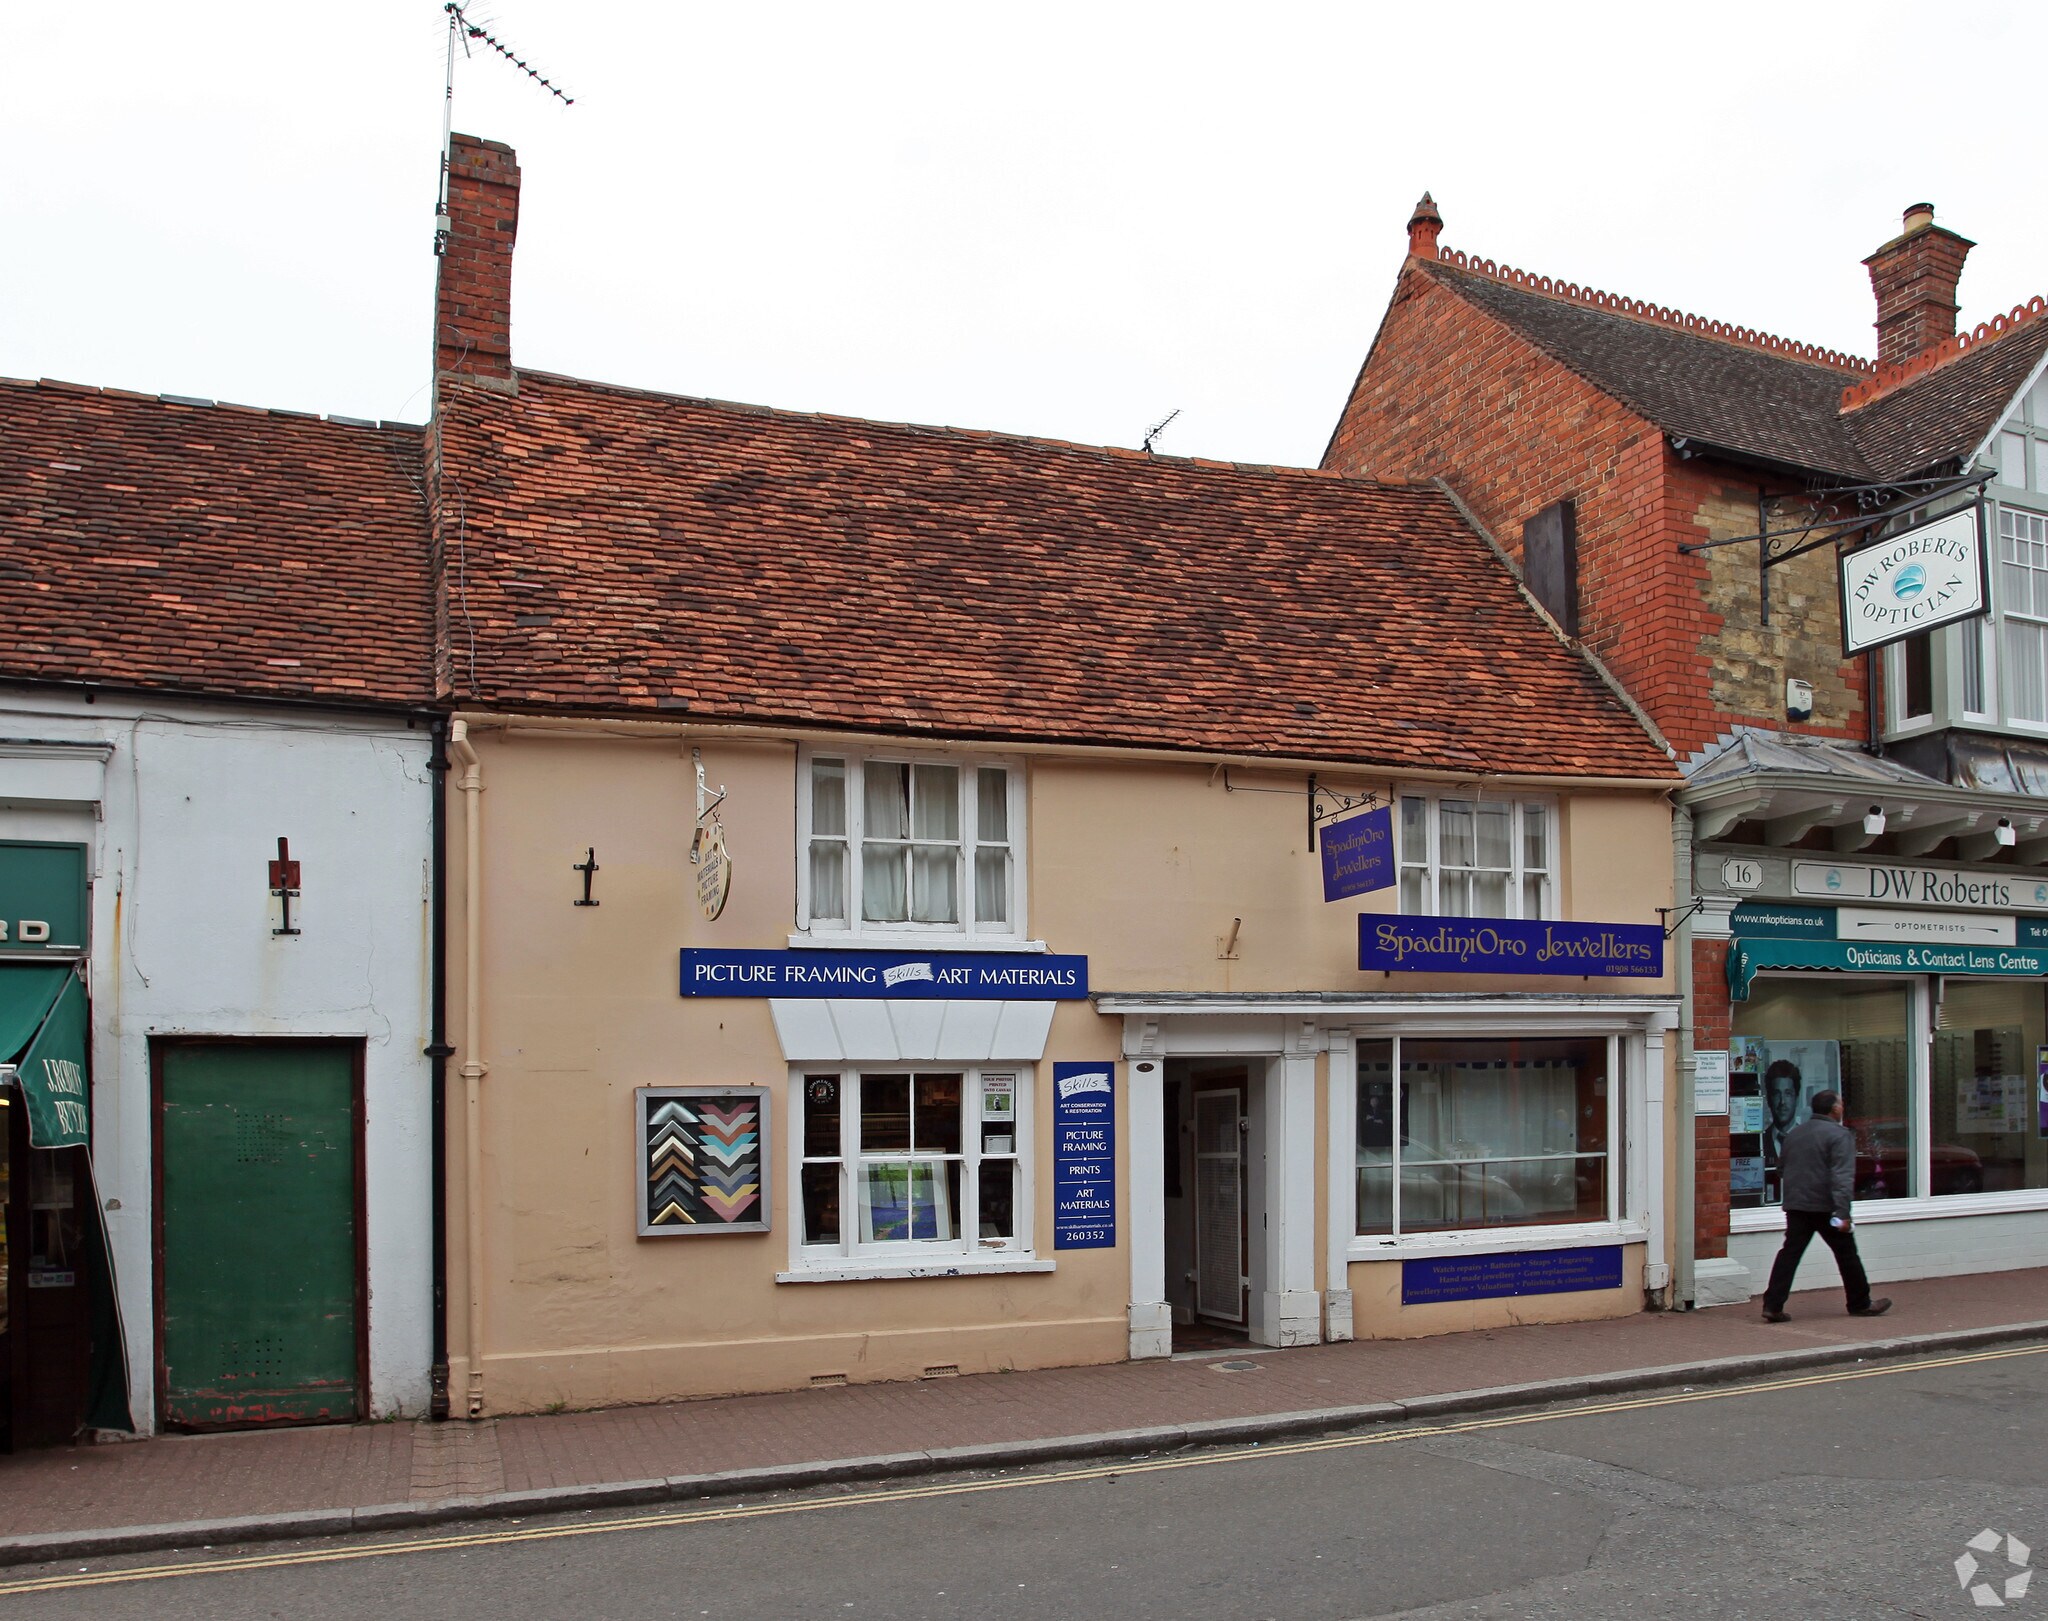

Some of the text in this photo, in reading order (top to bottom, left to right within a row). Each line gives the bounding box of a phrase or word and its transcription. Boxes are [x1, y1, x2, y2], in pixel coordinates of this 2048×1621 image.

[1854, 537, 1969, 602] DW ROBERTS
[1863, 573, 1963, 624] OPTICIAN
[1326, 828, 1385, 859] SpadiniOro
[704, 849, 712, 863] ART
[697, 856, 719, 883] MATERIALS
[1333, 855, 1382, 881] Jewellers
[1735, 864, 1752, 884] 16
[701, 870, 719, 893] PICTURE
[1869, 867, 2010, 906] DW Roberts
[701, 884, 720, 906] FRAMING
[1734, 913, 1824, 928] www.mkopticians.co.uk
[1894, 922, 1966, 933] OPTOMETRISTS
[1375, 923, 1652, 962] SpadiniOro Jewellers
[1846, 947, 2039, 970] Opticians & Contact Lens Centre
[695, 964, 1076, 986] PICTURE FRAMING Skills ART MATERIALS
[1605, 965, 1658, 974] 01908 566133
[1063, 1077, 1099, 1093] Skills
[1066, 1130, 1104, 1140] PICTURE
[1063, 1142, 1107, 1152] FRAMING
[1069, 1165, 1101, 1175] PRINTS
[1735, 1158, 1751, 1166] FREE
[1076, 1189, 1094, 1198] ART
[1060, 1200, 1110, 1210] MATERIALS
[1066, 1231, 1105, 1241] 260352
[1457, 1264, 1482, 1273] repairs
[1528, 1259, 1551, 1267] Straps
[1558, 1256, 1594, 1265] Engraving
[1462, 1274, 1480, 1282] made
[1482, 1272, 1514, 1281] jewellery
[1524, 1269, 1541, 1277] Gem
[1542, 1266, 1587, 1276] replacements
[1406, 1288, 1440, 1297] Jewellery
[1443, 1286, 1468, 1294] repairs
[1477, 1283, 1514, 1291] Valuations
[1522, 1278, 1556, 1287] Polishing
[1564, 1275, 1594, 1284] cleaning
[1595, 1273, 1618, 1281] service
